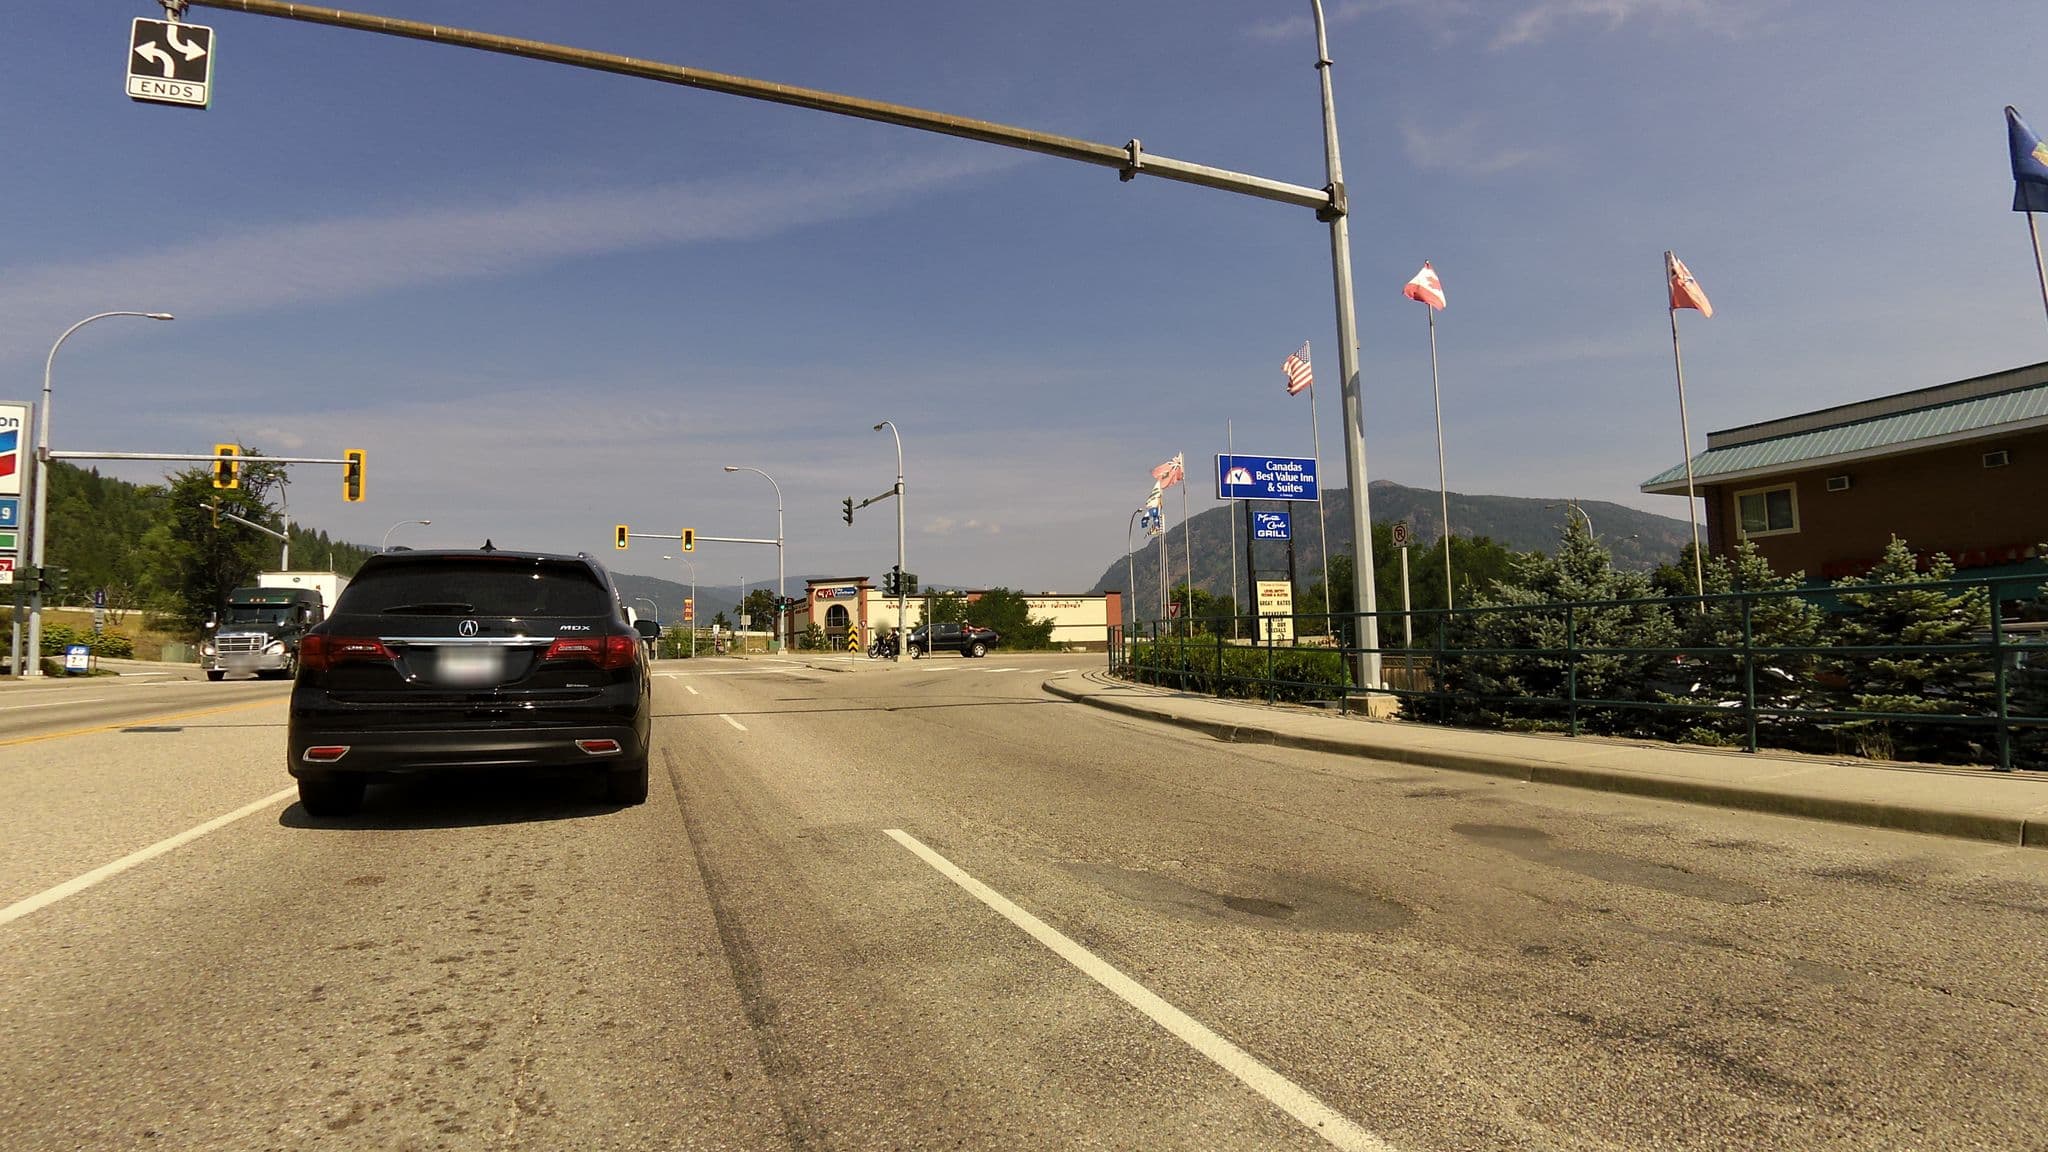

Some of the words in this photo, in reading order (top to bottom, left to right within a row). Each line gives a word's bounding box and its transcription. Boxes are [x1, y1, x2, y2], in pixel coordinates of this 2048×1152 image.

[141, 81, 193, 98] ENDS
[1266, 461, 1303, 472] Canadas
[1256, 471, 1274, 481] Best
[1275, 471, 1299, 482] Value
[1300, 473, 1314, 483] Inn
[1267, 482, 1275, 492] &
[1277, 482, 1303, 493] Suites
[1257, 530, 1287, 538] GRILL
